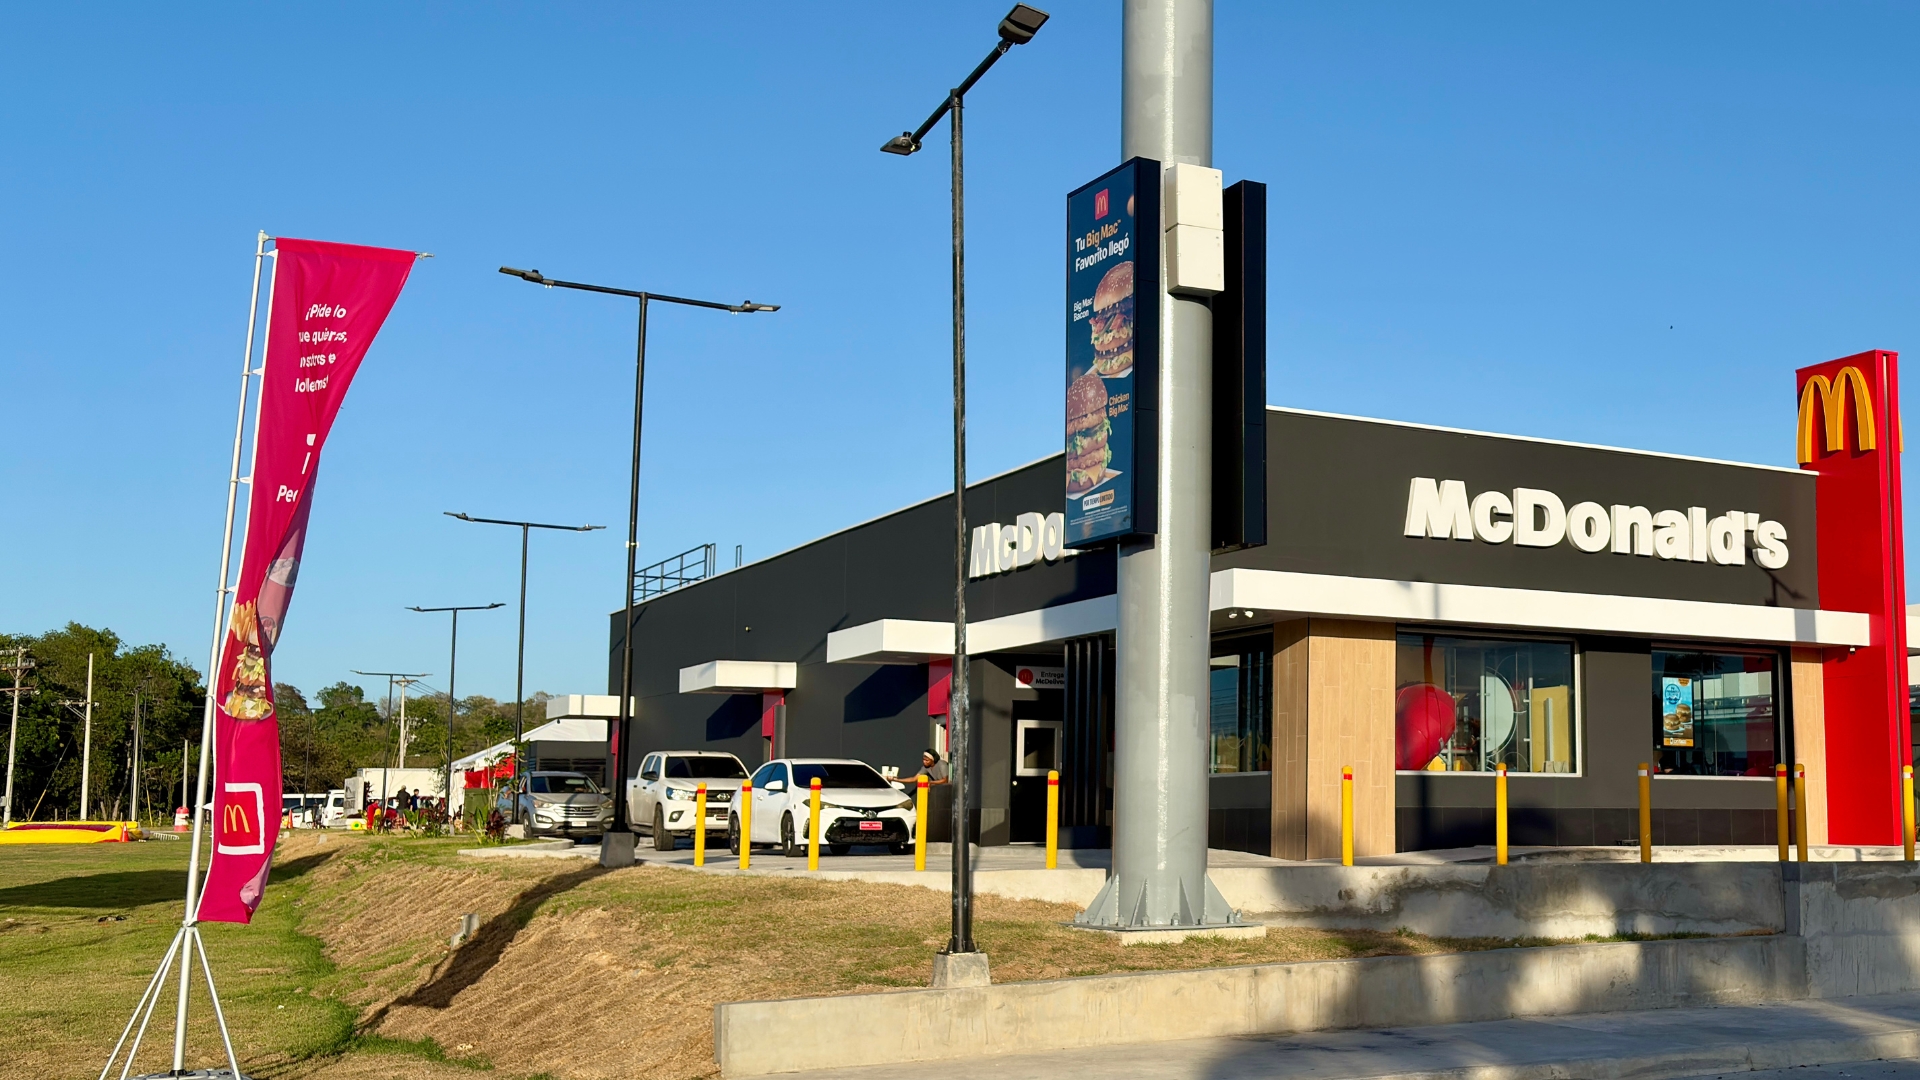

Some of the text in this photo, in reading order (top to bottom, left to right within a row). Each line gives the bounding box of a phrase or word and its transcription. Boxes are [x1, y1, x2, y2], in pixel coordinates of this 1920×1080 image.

[1075, 237, 1086, 252] Tu
[1086, 229, 1100, 248] Big
[1075, 231, 1130, 273] Favorito llegó
[305, 303, 347, 321] ¡Pide lo
[1073, 300, 1082, 312] Big
[1073, 309, 1089, 322] Bacon
[1109, 392, 1130, 406] Chicken
[1109, 406, 1118, 418] Big
[1404, 476, 1789, 570] McDonald's
